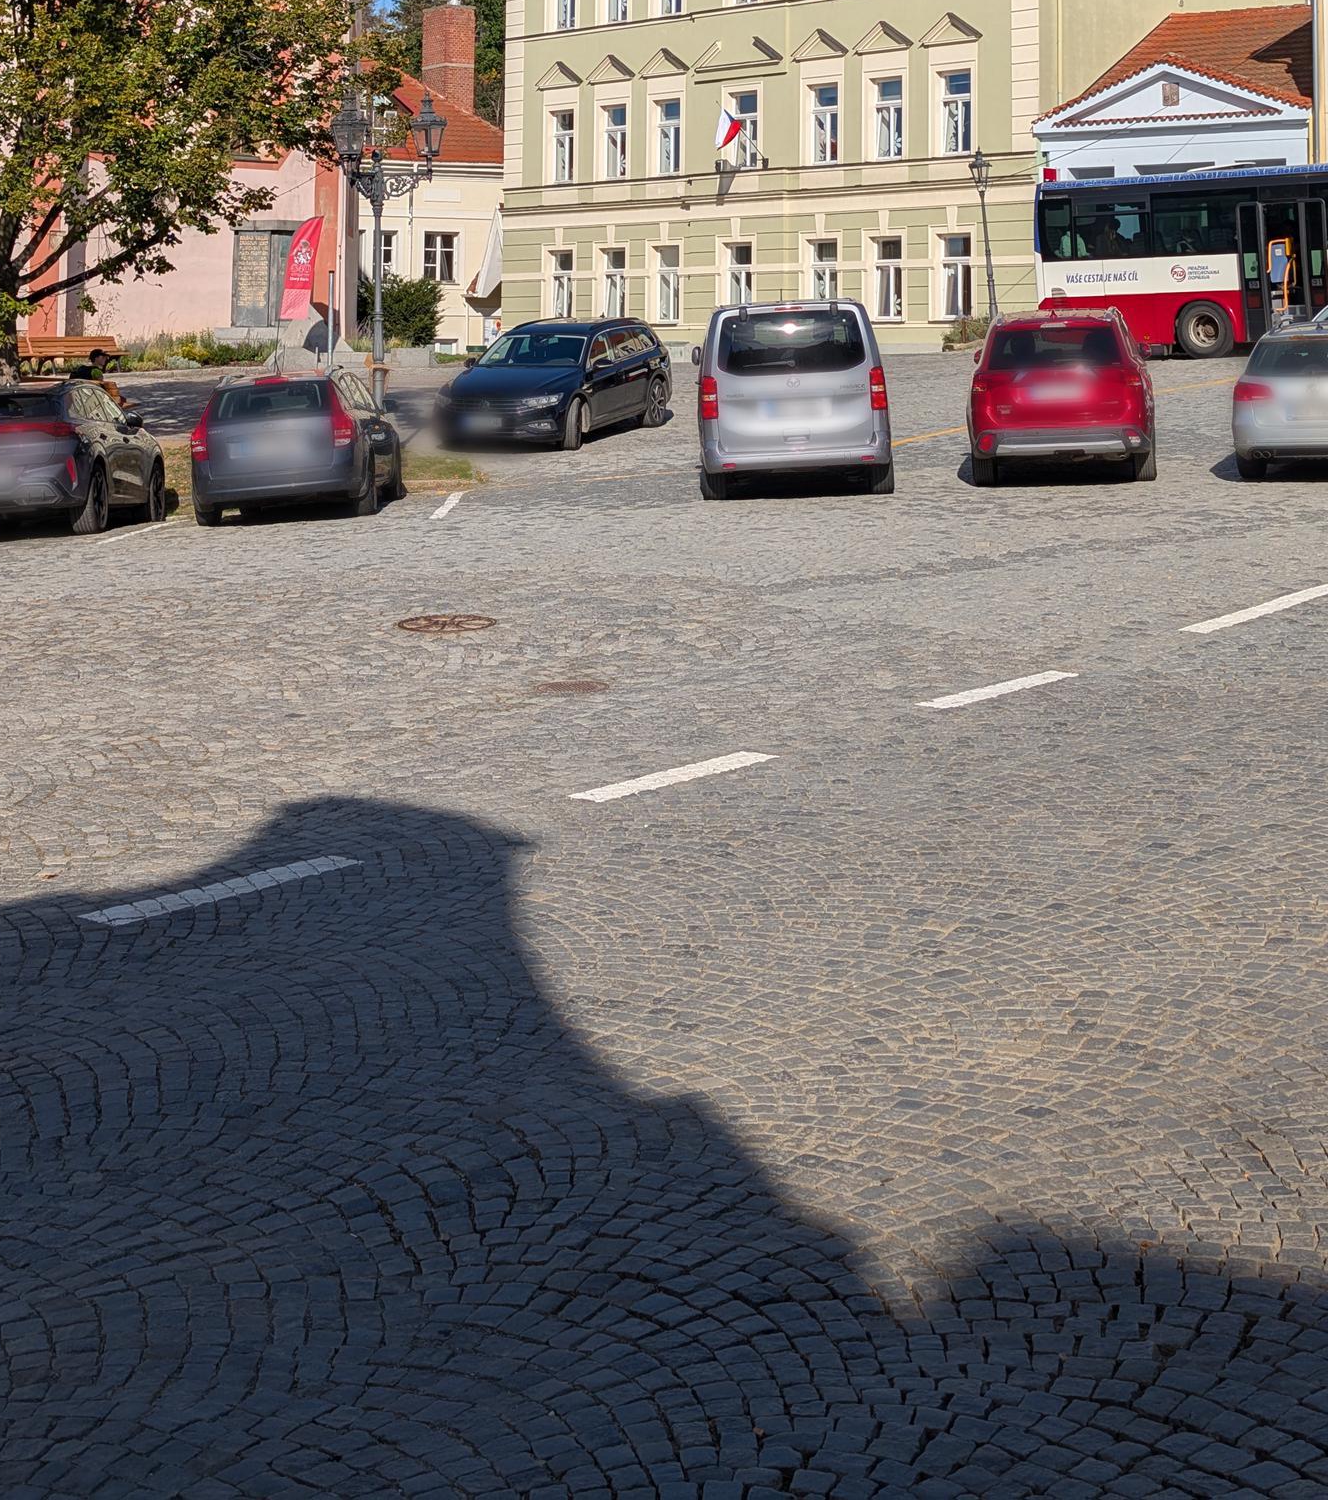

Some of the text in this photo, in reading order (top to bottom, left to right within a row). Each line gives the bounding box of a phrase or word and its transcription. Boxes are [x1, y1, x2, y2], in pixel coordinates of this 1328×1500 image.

[1066, 270, 1139, 284] VAŠE CESTA JE NAŠ CÍL
